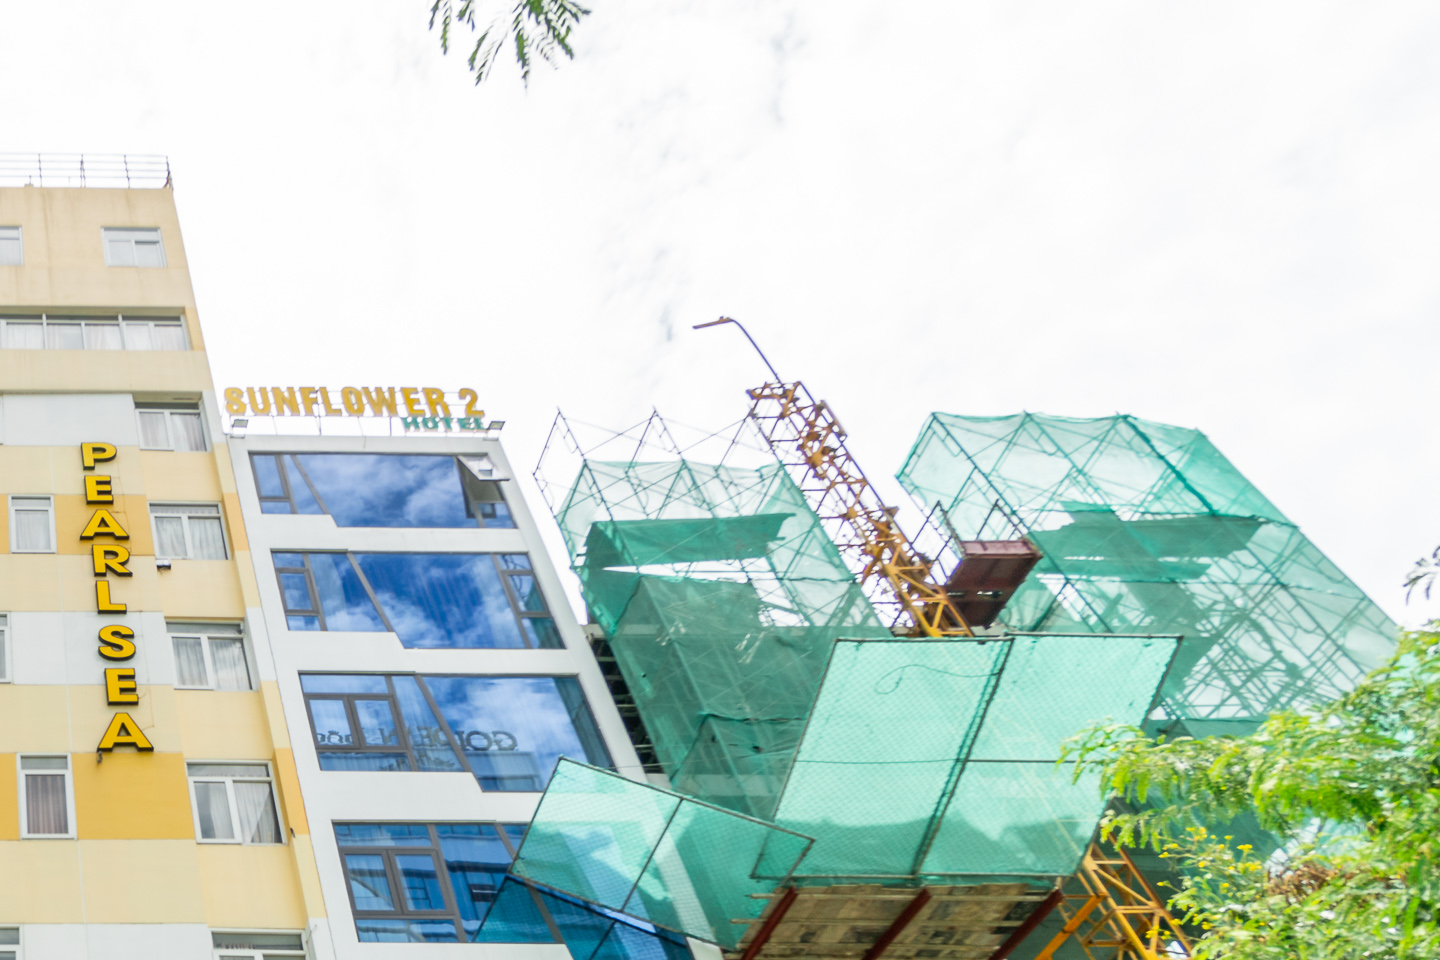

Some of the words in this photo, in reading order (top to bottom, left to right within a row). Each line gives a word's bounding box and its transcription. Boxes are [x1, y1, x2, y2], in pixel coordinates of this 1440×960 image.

[224, 386, 452, 417] SUNFLOWER
[459, 388, 486, 417] 2
[401, 416, 488, 434] HOTEL
